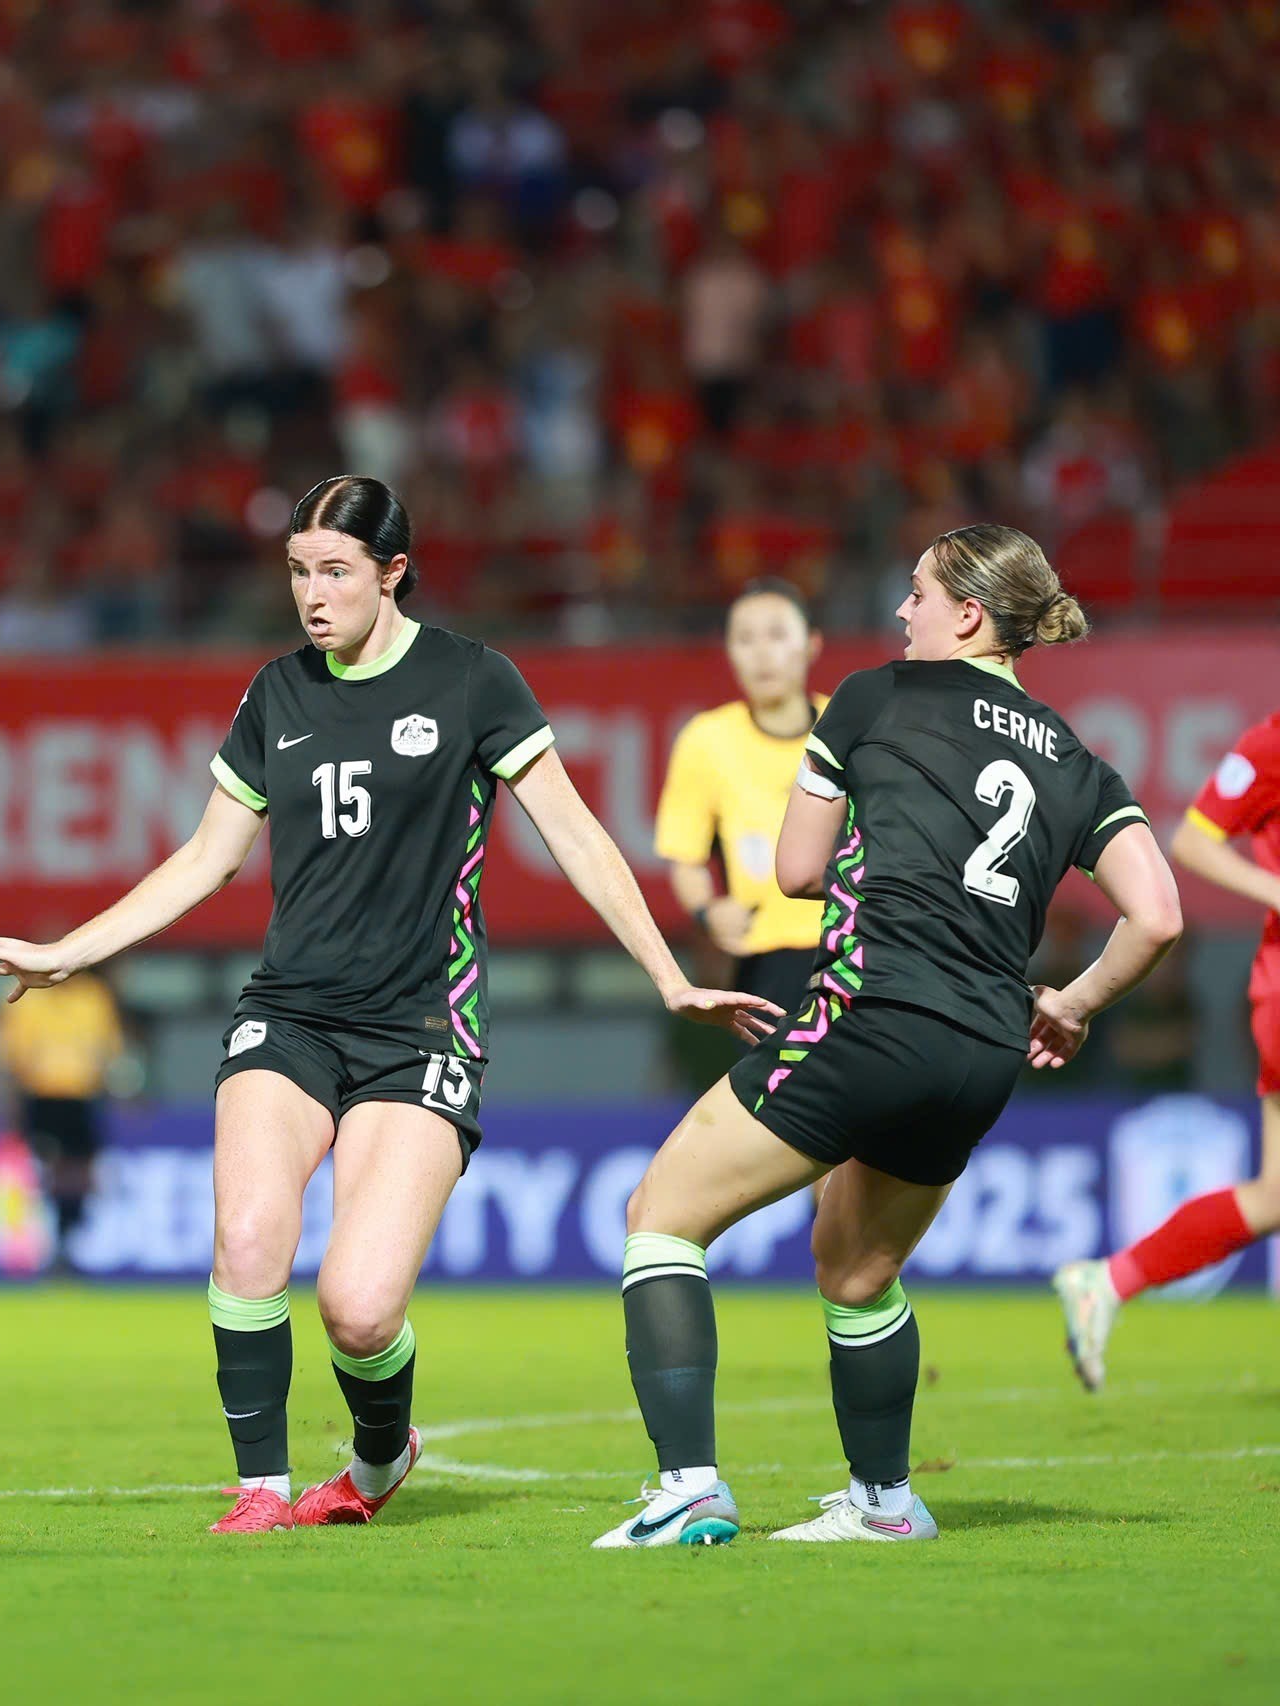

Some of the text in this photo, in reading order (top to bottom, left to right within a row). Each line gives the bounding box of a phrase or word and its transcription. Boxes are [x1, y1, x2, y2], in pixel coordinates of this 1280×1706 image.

[973, 698, 1059, 763] CERNE
[312, 760, 372, 839] 15
[963, 759, 1036, 908] 2
[418, 1049, 472, 1110] 15
